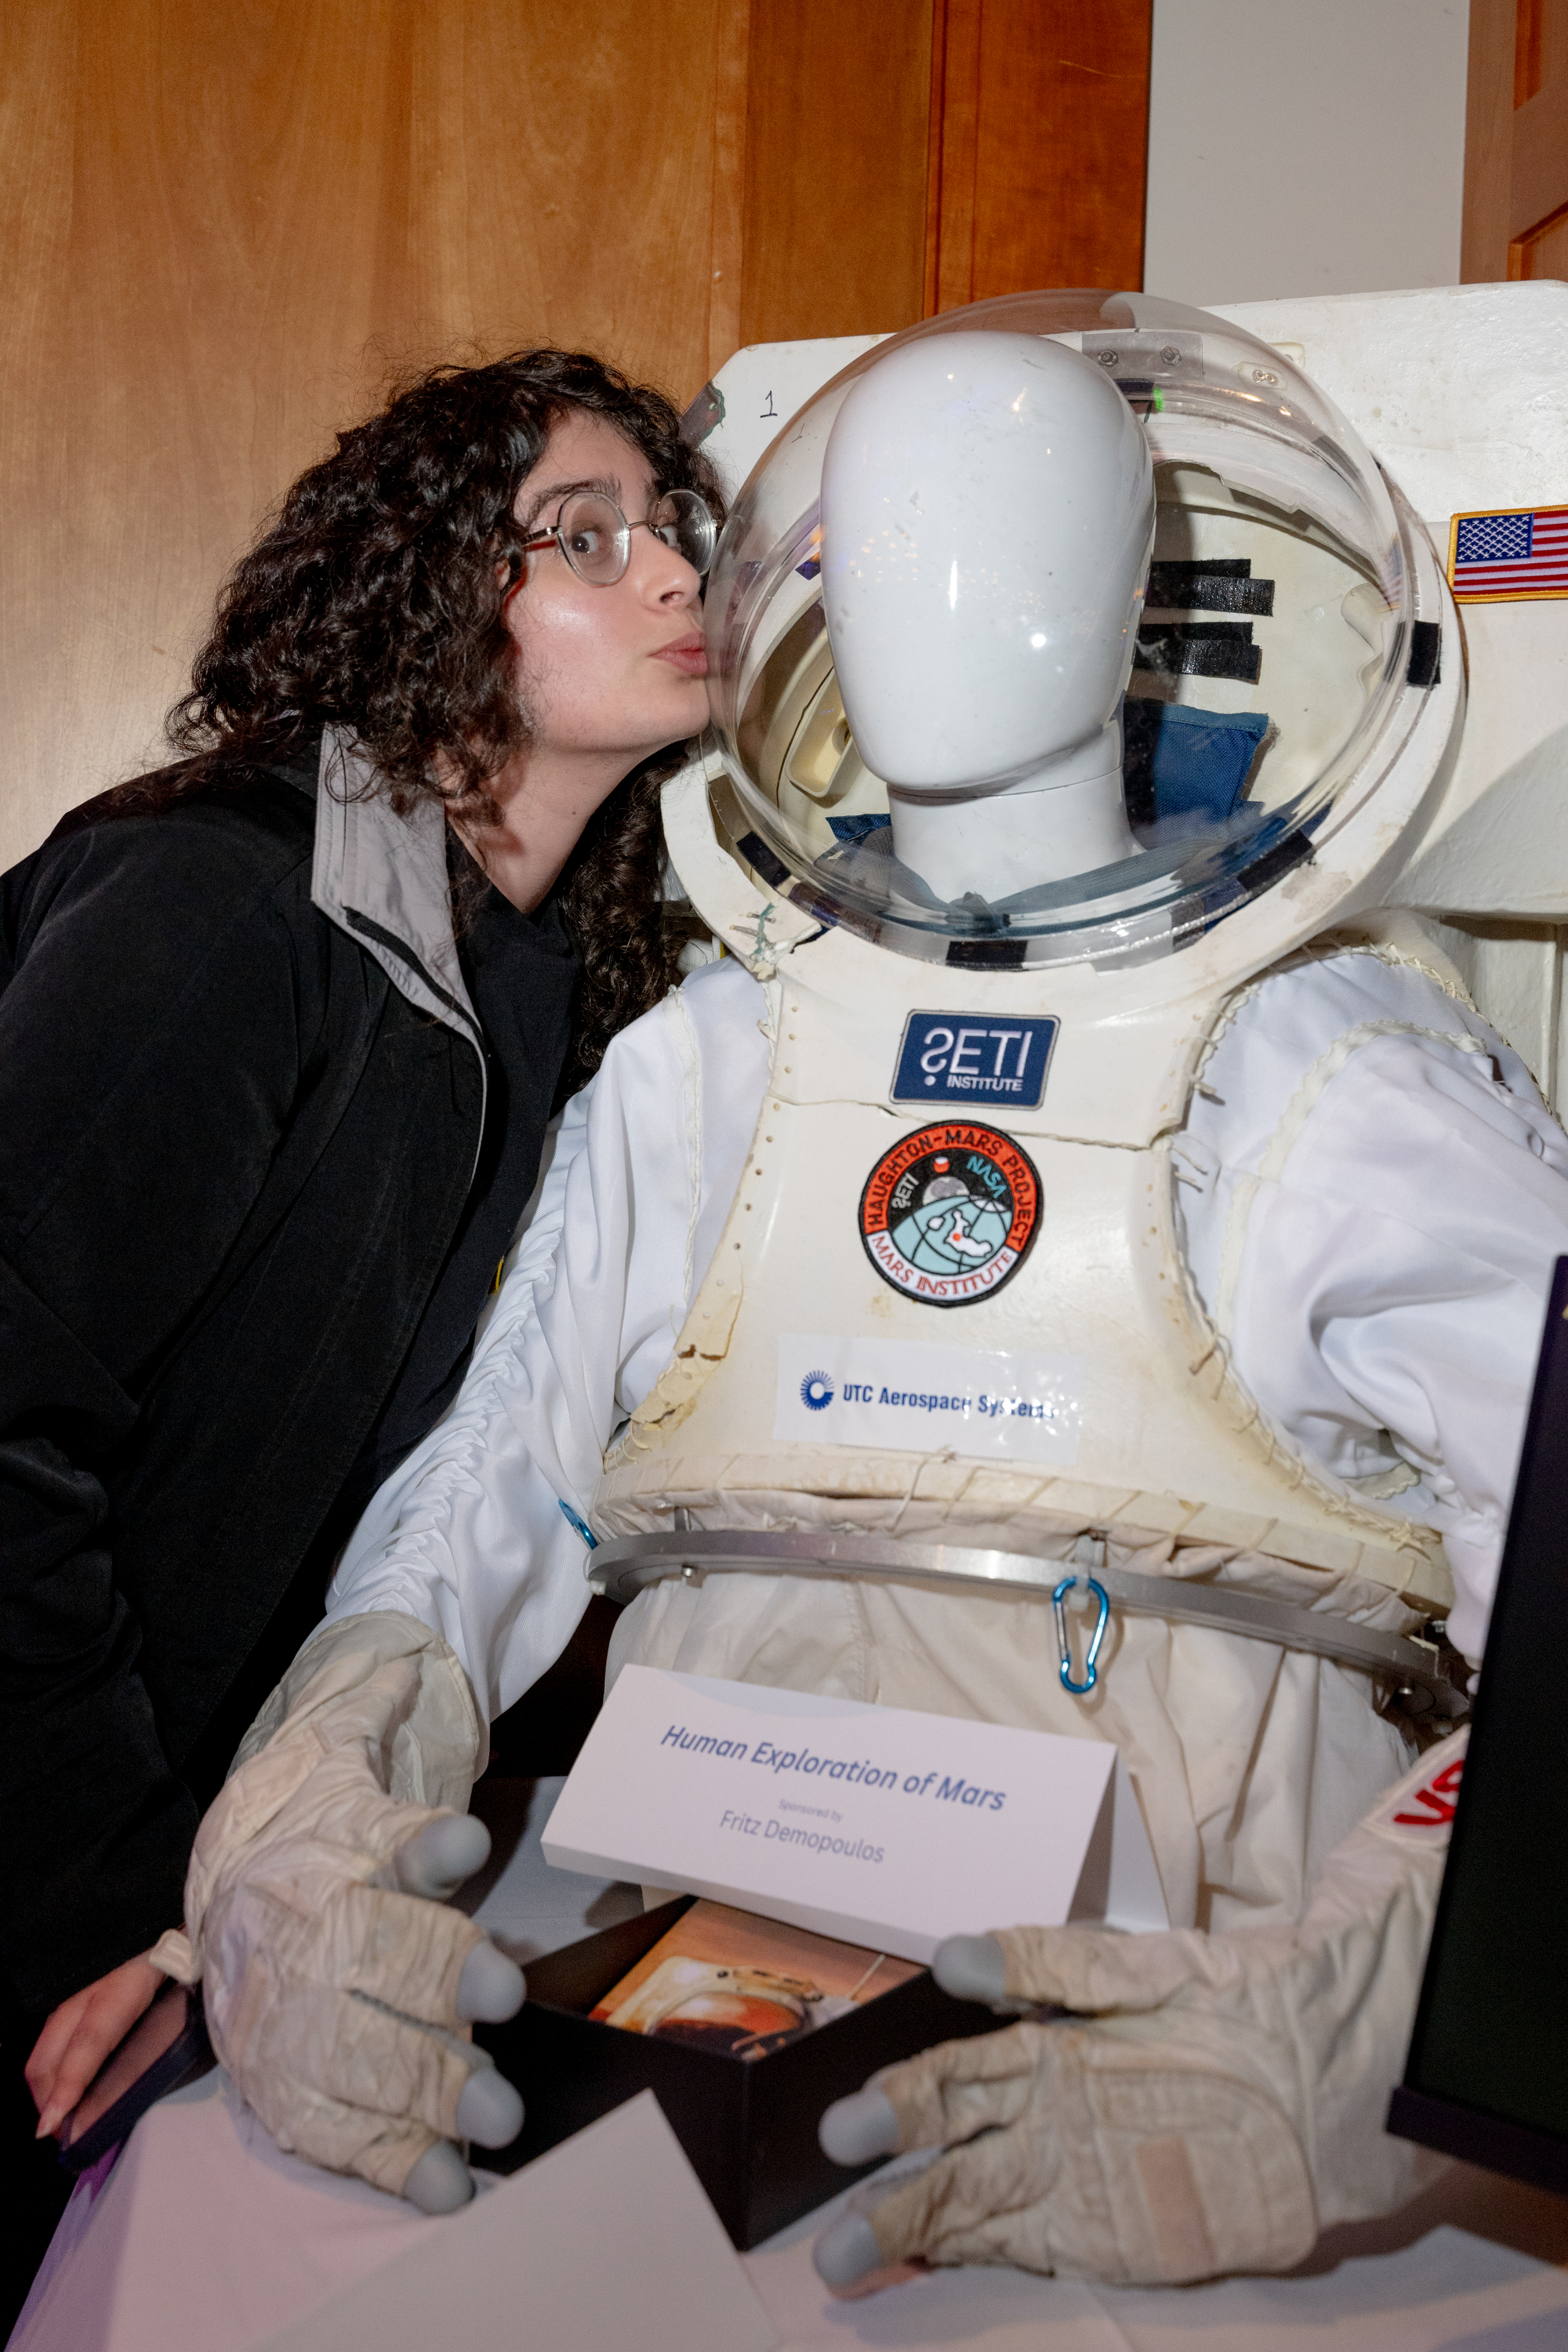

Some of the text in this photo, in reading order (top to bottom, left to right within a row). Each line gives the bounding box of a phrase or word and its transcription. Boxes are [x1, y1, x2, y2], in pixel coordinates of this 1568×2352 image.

[760, 390, 778, 418] 1
[946, 1074, 1023, 1091] INSTITUTE
[966, 1156, 1007, 1199] NASA
[1002, 1155, 1031, 1243] PROJECT
[873, 1236, 1012, 1296] MARS INSTITUTE
[843, 1385, 873, 1403] UTC
[660, 1725, 1007, 1811] Human Exploration of Mars
[719, 1809, 885, 1864] Fritz Demopoulos
[830, 1810, 844, 1824] by
